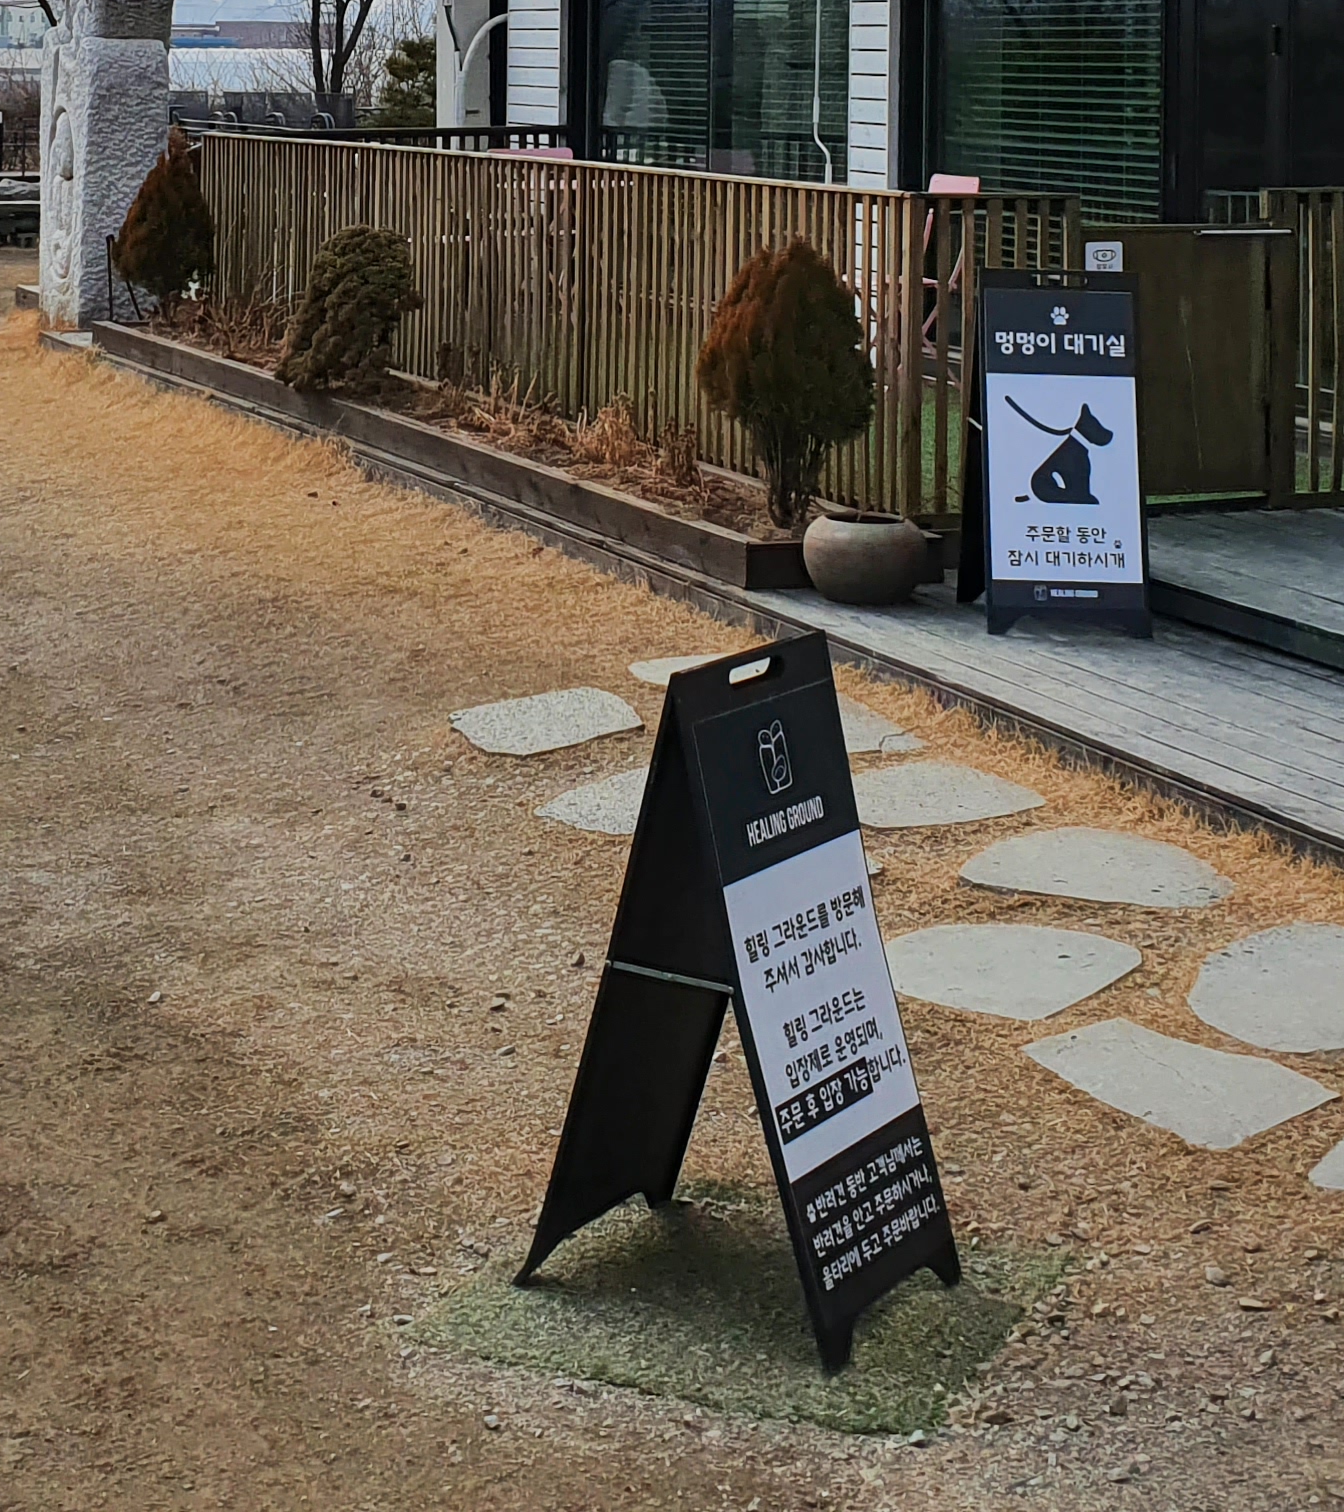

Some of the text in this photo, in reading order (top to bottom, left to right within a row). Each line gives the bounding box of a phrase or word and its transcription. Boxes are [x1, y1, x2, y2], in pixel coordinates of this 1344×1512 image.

[994, 331, 1126, 358] 멍멍이 대기실
[1007, 549, 1126, 569] 잠시 대기하시개
[1025, 525, 1108, 545] 주문할 동안
[746, 795, 825, 848] HEALING GROUND
[744, 884, 866, 964] 힐링 그라운드를 방문해
[763, 927, 863, 994] 주셔서 감사합니다.
[783, 987, 867, 1049] 힐링 그라운드는
[785, 1016, 884, 1089] 입장제로 운영되며,
[778, 1100, 806, 1135] 주문
[805, 1090, 820, 1120] 후
[819, 1078, 845, 1112] 입장
[814, 1136, 924, 1219] 반려견 동반 고객님께서는
[812, 1162, 934, 1259] 반려견을 안고 주문하시거나,
[821, 1246, 863, 1291] 울타리에
[861, 1232, 884, 1262] 두고
